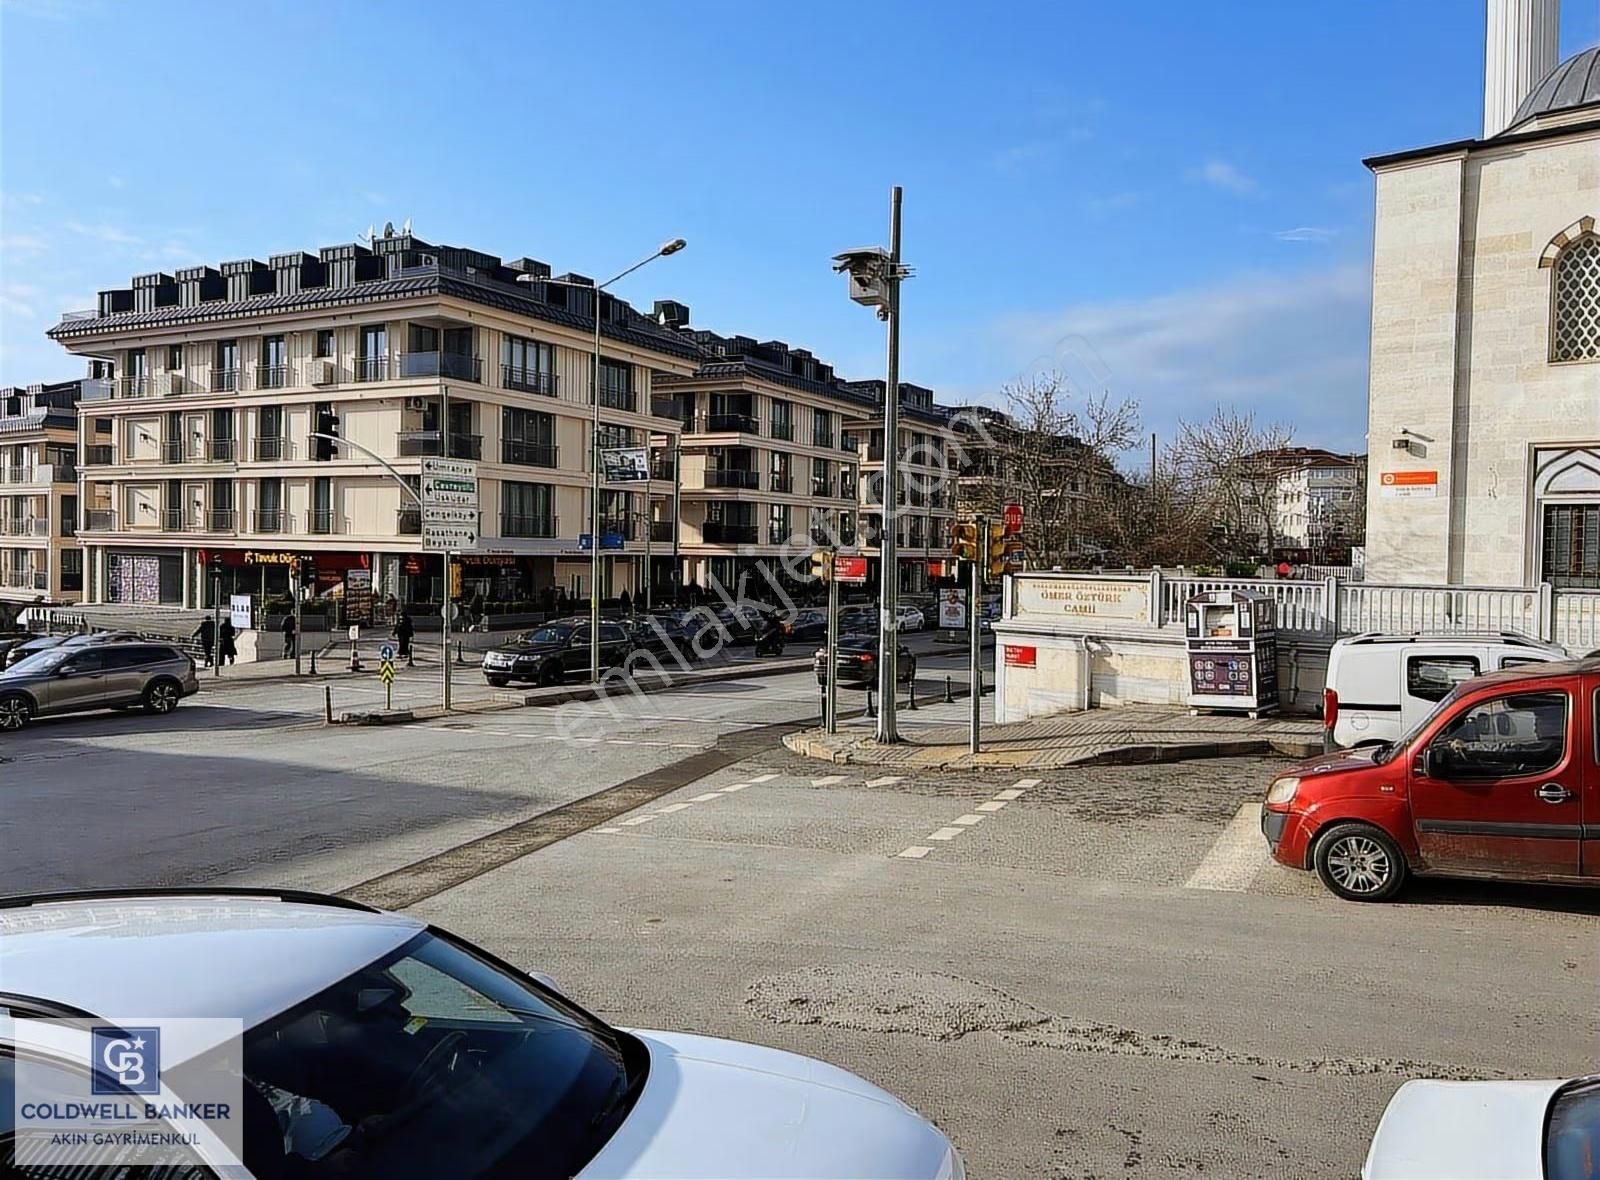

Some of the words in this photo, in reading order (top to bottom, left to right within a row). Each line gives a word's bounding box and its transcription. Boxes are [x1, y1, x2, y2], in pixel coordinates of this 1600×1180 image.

[254, 552, 279, 564] Tavuk
[1041, 589, 1073, 601] ÖMER
[1075, 591, 1121, 603] ÖZTÜRK
